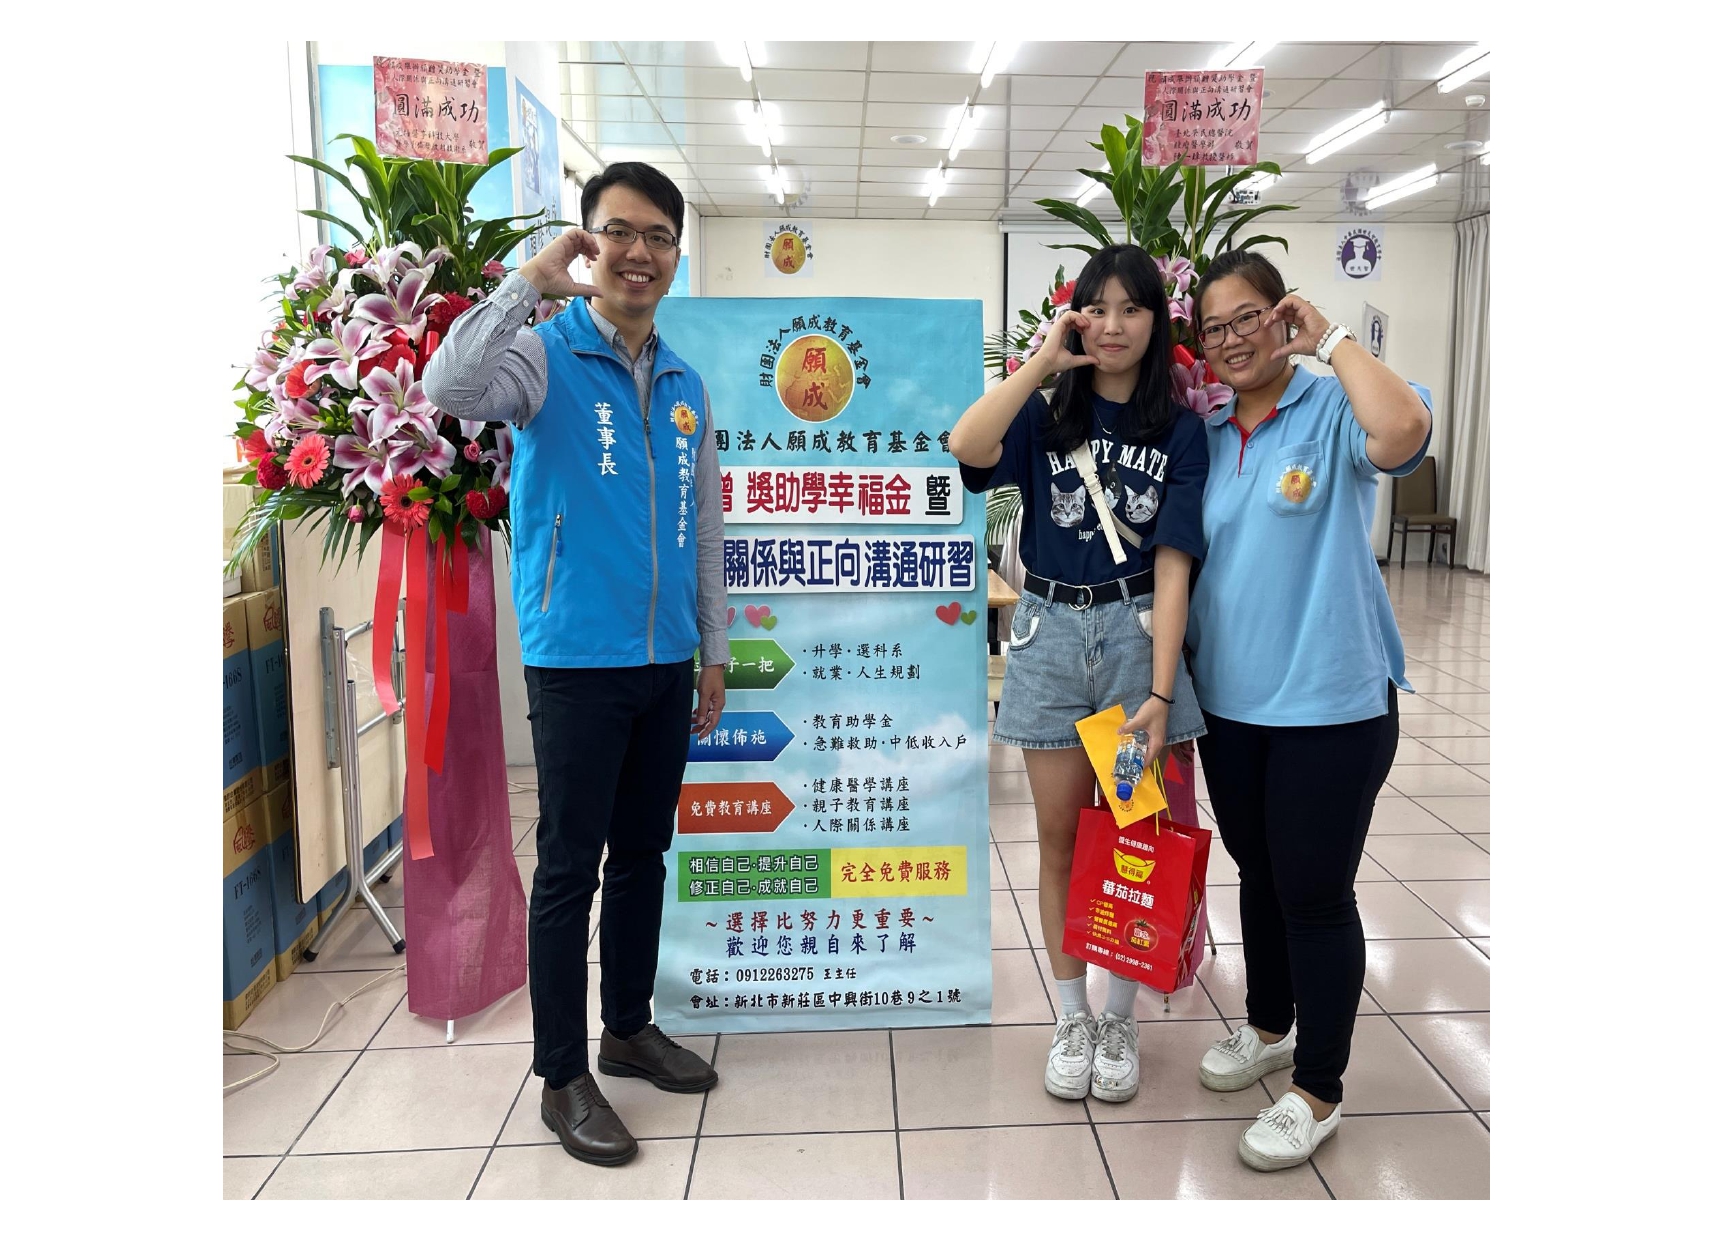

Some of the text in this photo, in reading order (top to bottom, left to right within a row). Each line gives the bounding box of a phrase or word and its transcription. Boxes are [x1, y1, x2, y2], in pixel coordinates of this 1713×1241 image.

[395, 93, 479, 123] 圓滿成功
[1161, 97, 1251, 122] 圓滿成功
[782, 238, 795, 269] 願成
[759, 314, 872, 389] 財團法人願成教育基金會
[802, 347, 828, 411] 願成
[594, 402, 619, 476] 董事長
[1046, 438, 1169, 483] HAPY MATE
[675, 436, 691, 548] 願成教育基金會
[746, 471, 911, 516] 獎助學幸福金
[925, 474, 951, 516] 暨
[724, 538, 974, 588] 關係與正向溝通研習
[812, 714, 893, 729] 教育助學金
[812, 777, 910, 793] 健康醫學講座
[690, 800, 772, 817] 免費教育講座
[812, 797, 910, 813] 親子教育講座
[812, 817, 910, 833] 人際關係講座
[841, 860, 952, 883] 完全免費服務
[1102, 879, 1154, 910] 蕃茄拉麵
[726, 932, 917, 958] 歡迎您親自來了解
[823, 968, 857, 980] 王主任
